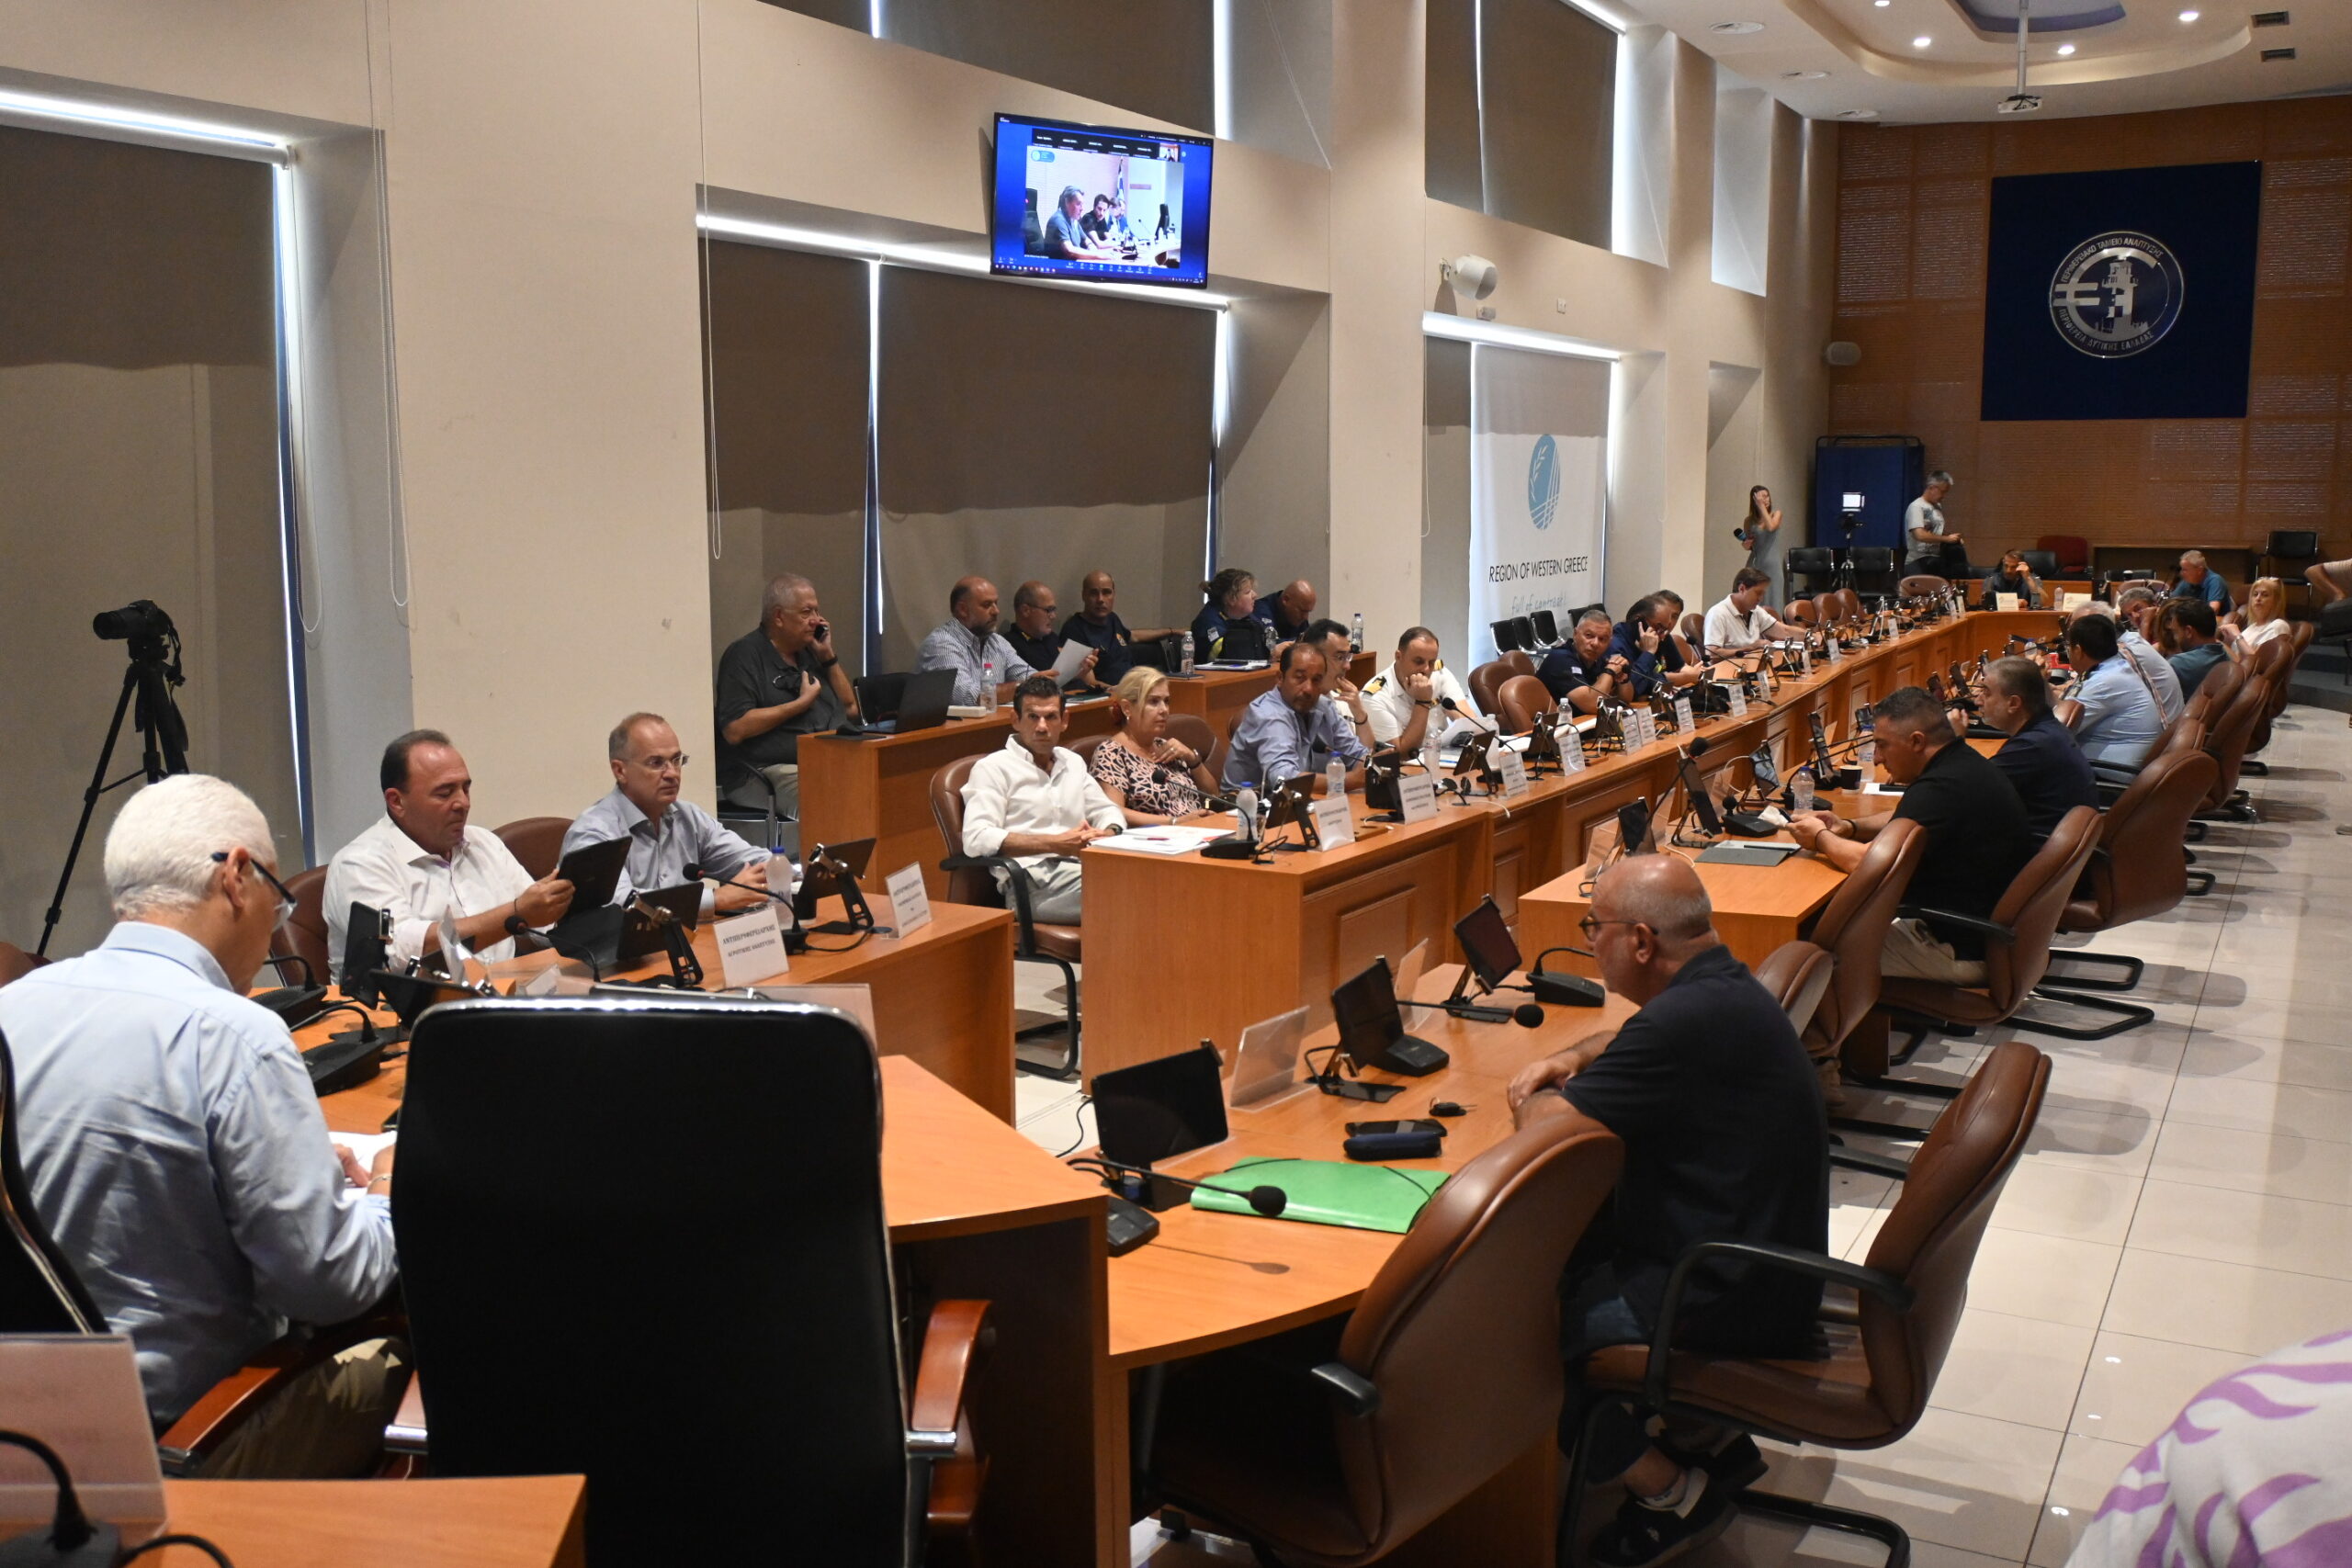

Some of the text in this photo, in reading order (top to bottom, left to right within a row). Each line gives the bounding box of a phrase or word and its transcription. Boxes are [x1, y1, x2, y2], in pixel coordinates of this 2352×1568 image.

[2097, 237, 2123, 250] ΤΑΜΕΙΟ
[2123, 237, 2165, 258] ΑΝΑΠΤΥΞΗΣ
[2058, 308, 2154, 351] ΠΕΡΙΦΕΡΕΙΑ ΔΥΤΙΚΗΣ ΕΛΛΑΔΑΣ
[1488, 556, 1589, 583] REGION OF WESTERN GREECE
